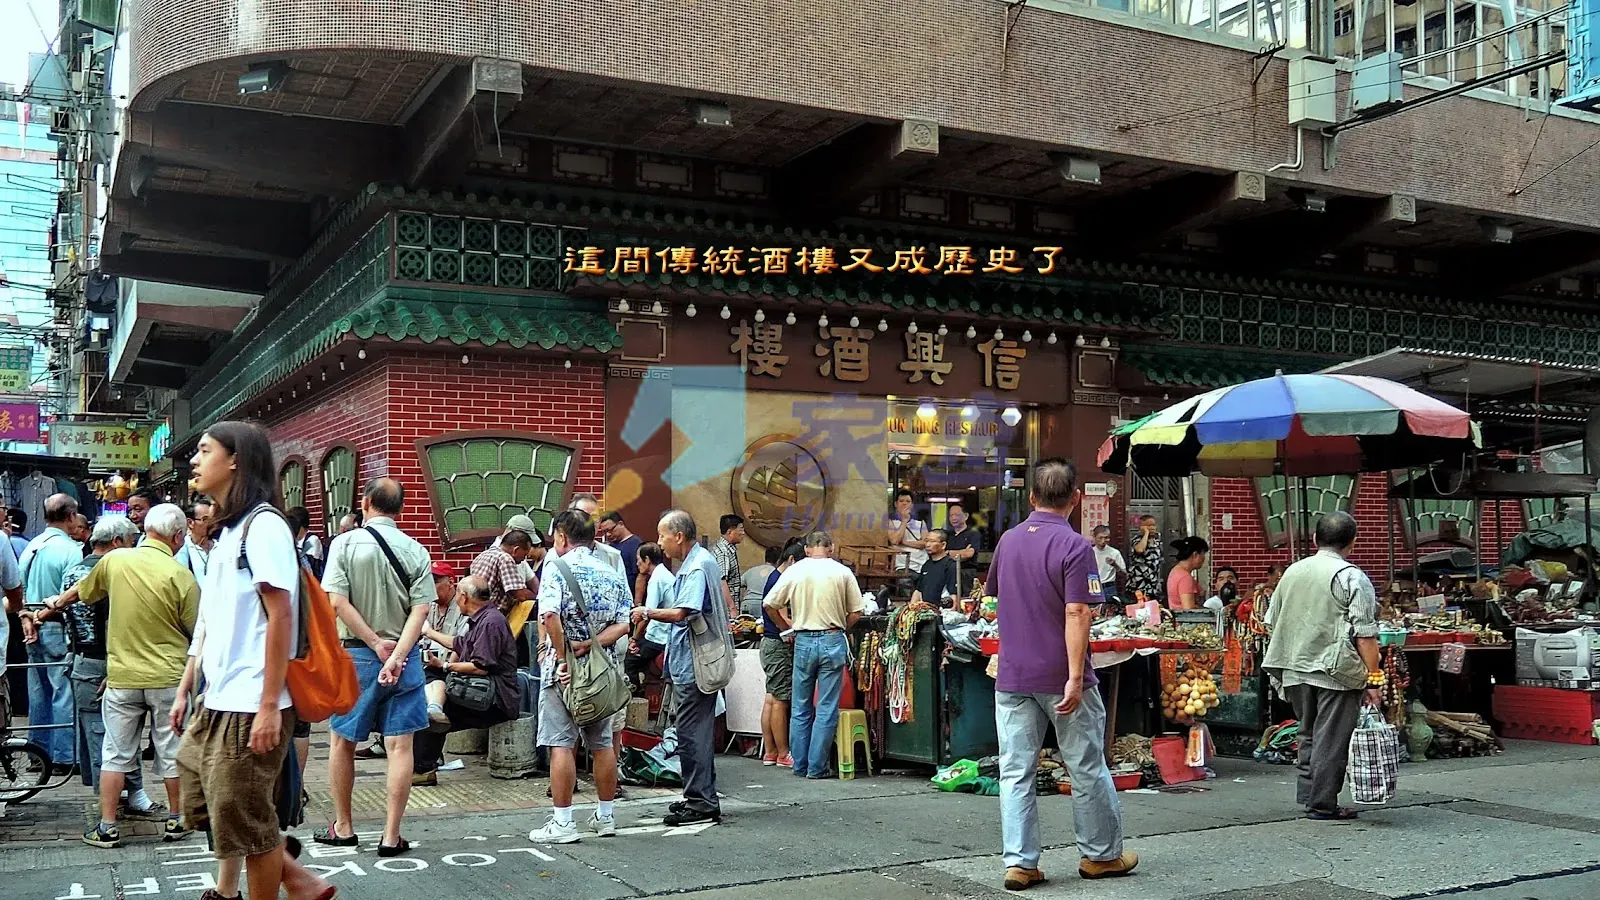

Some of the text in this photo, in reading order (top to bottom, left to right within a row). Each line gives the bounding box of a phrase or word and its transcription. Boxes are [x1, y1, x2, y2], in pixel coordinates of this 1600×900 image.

[912, 418, 940, 435] HING
[304, 846, 557, 880] LOOK
[54, 872, 218, 900] EFT
